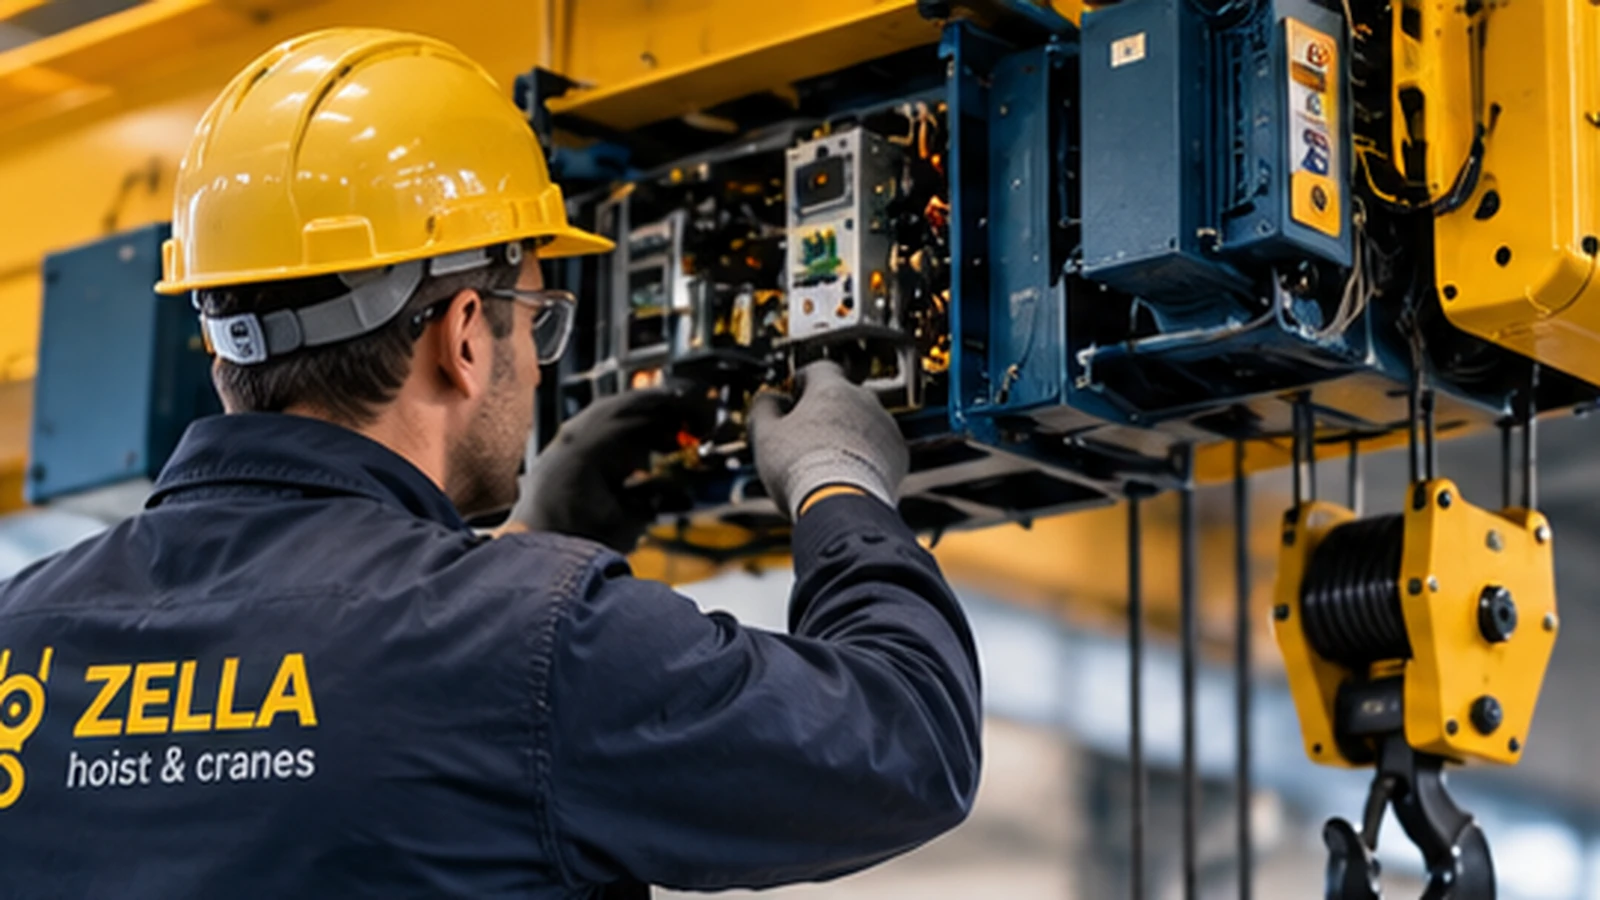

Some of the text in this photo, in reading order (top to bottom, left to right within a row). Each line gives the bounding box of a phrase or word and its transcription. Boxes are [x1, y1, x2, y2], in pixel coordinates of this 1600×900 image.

[73, 653, 318, 737] ZELLA
[66, 746, 315, 787] hoist & cranes
